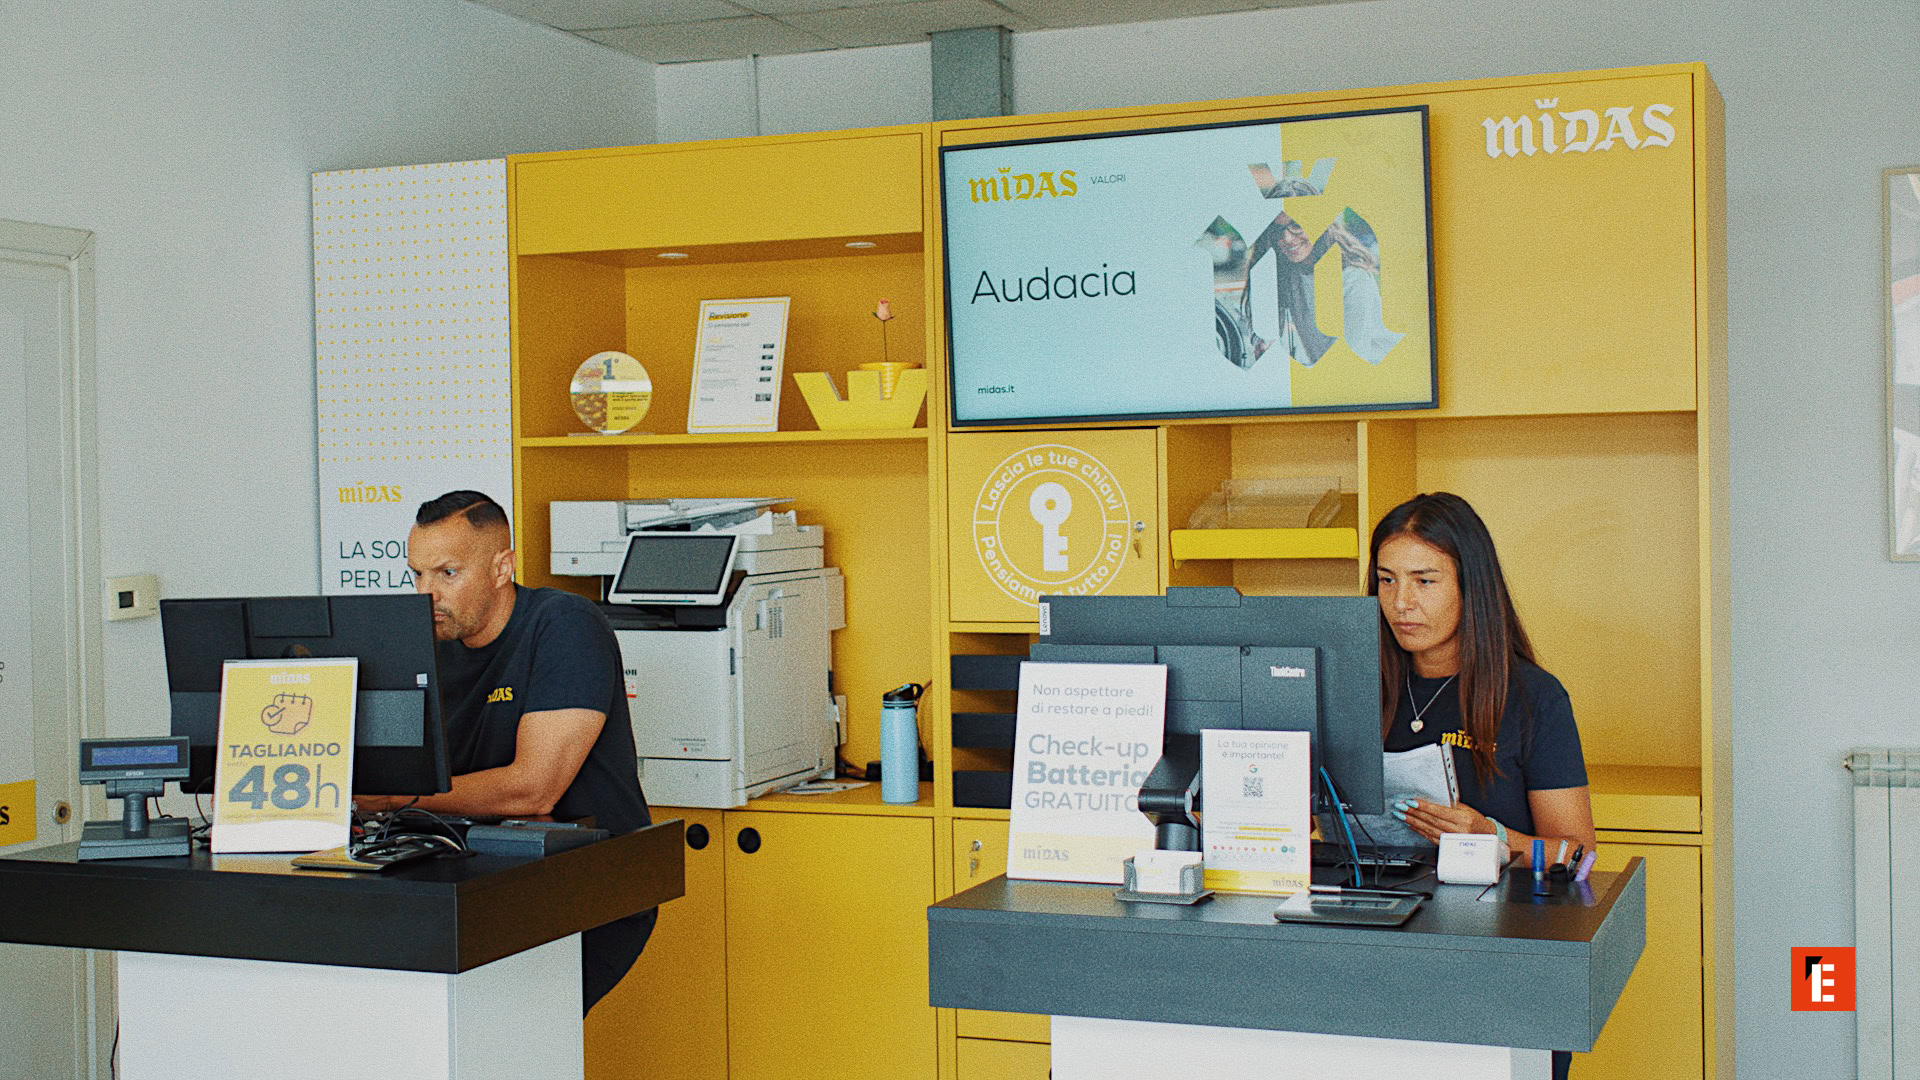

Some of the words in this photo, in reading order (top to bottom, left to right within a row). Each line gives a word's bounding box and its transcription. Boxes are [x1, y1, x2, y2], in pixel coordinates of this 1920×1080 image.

[1090, 174, 1126, 184] VALORI
[971, 263, 1136, 304] Audacia
[977, 385, 1015, 394] midas.it
[981, 463, 1024, 512] Lascia
[1027, 454, 1044, 467] le
[1049, 451, 1078, 468] tue
[1081, 463, 1122, 510] chiavi
[340, 541, 366, 558] LA
[371, 540, 408, 558] SOL
[1106, 533, 1122, 562] noi
[340, 570, 381, 588] PER
[388, 570, 414, 588] LA
[1033, 685, 1060, 696] Non
[1064, 685, 1134, 699] aspettare
[1031, 703, 1044, 713] di
[1047, 705, 1098, 715] restare
[1102, 706, 1111, 715] a
[1115, 705, 1153, 718] piedi!
[229, 743, 341, 758] TAGLIANDO
[1028, 734, 1149, 763] Check-up
[1217, 740, 1229, 748] La
[1232, 740, 1247, 748] tua
[1250, 741, 1288, 752] opinione
[228, 763, 339, 810] 48h
